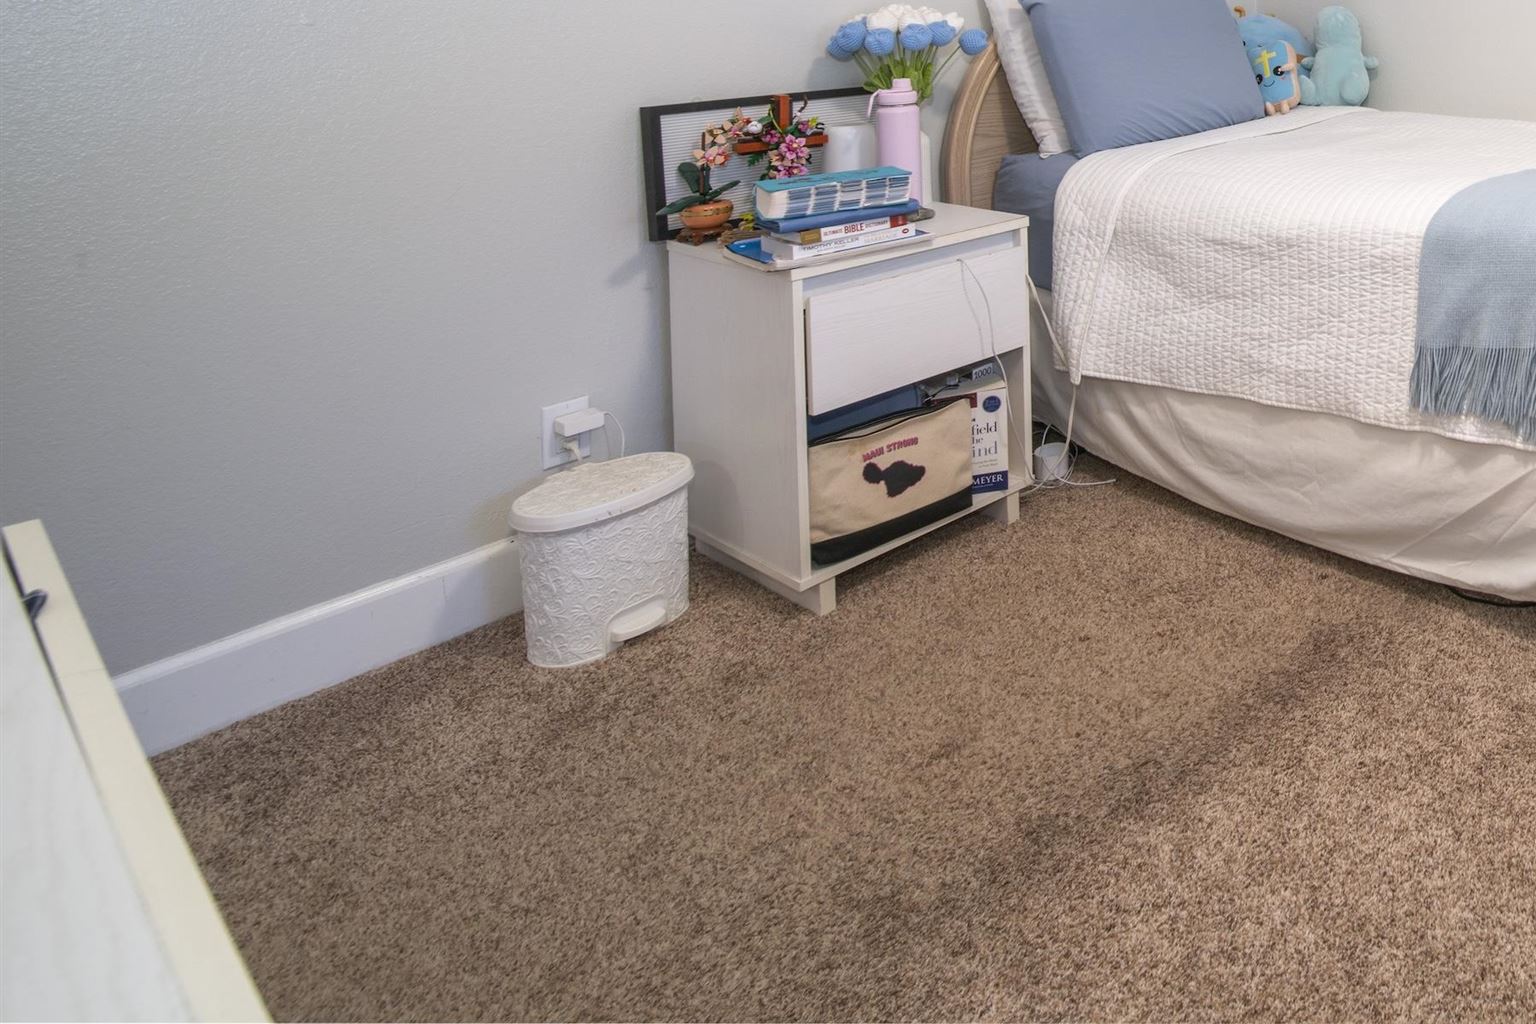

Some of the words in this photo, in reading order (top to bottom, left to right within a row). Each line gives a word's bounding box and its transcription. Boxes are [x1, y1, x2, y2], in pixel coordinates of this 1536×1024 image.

[844, 222, 865, 234] BIBLE
[802, 241, 833, 252] TIMOTHY
[834, 236, 860, 246] KELLER
[974, 366, 992, 380] 1000
[862, 446, 885, 463] MAUI
[886, 437, 919, 453] STRONG
[973, 473, 1004, 485] MEYER
